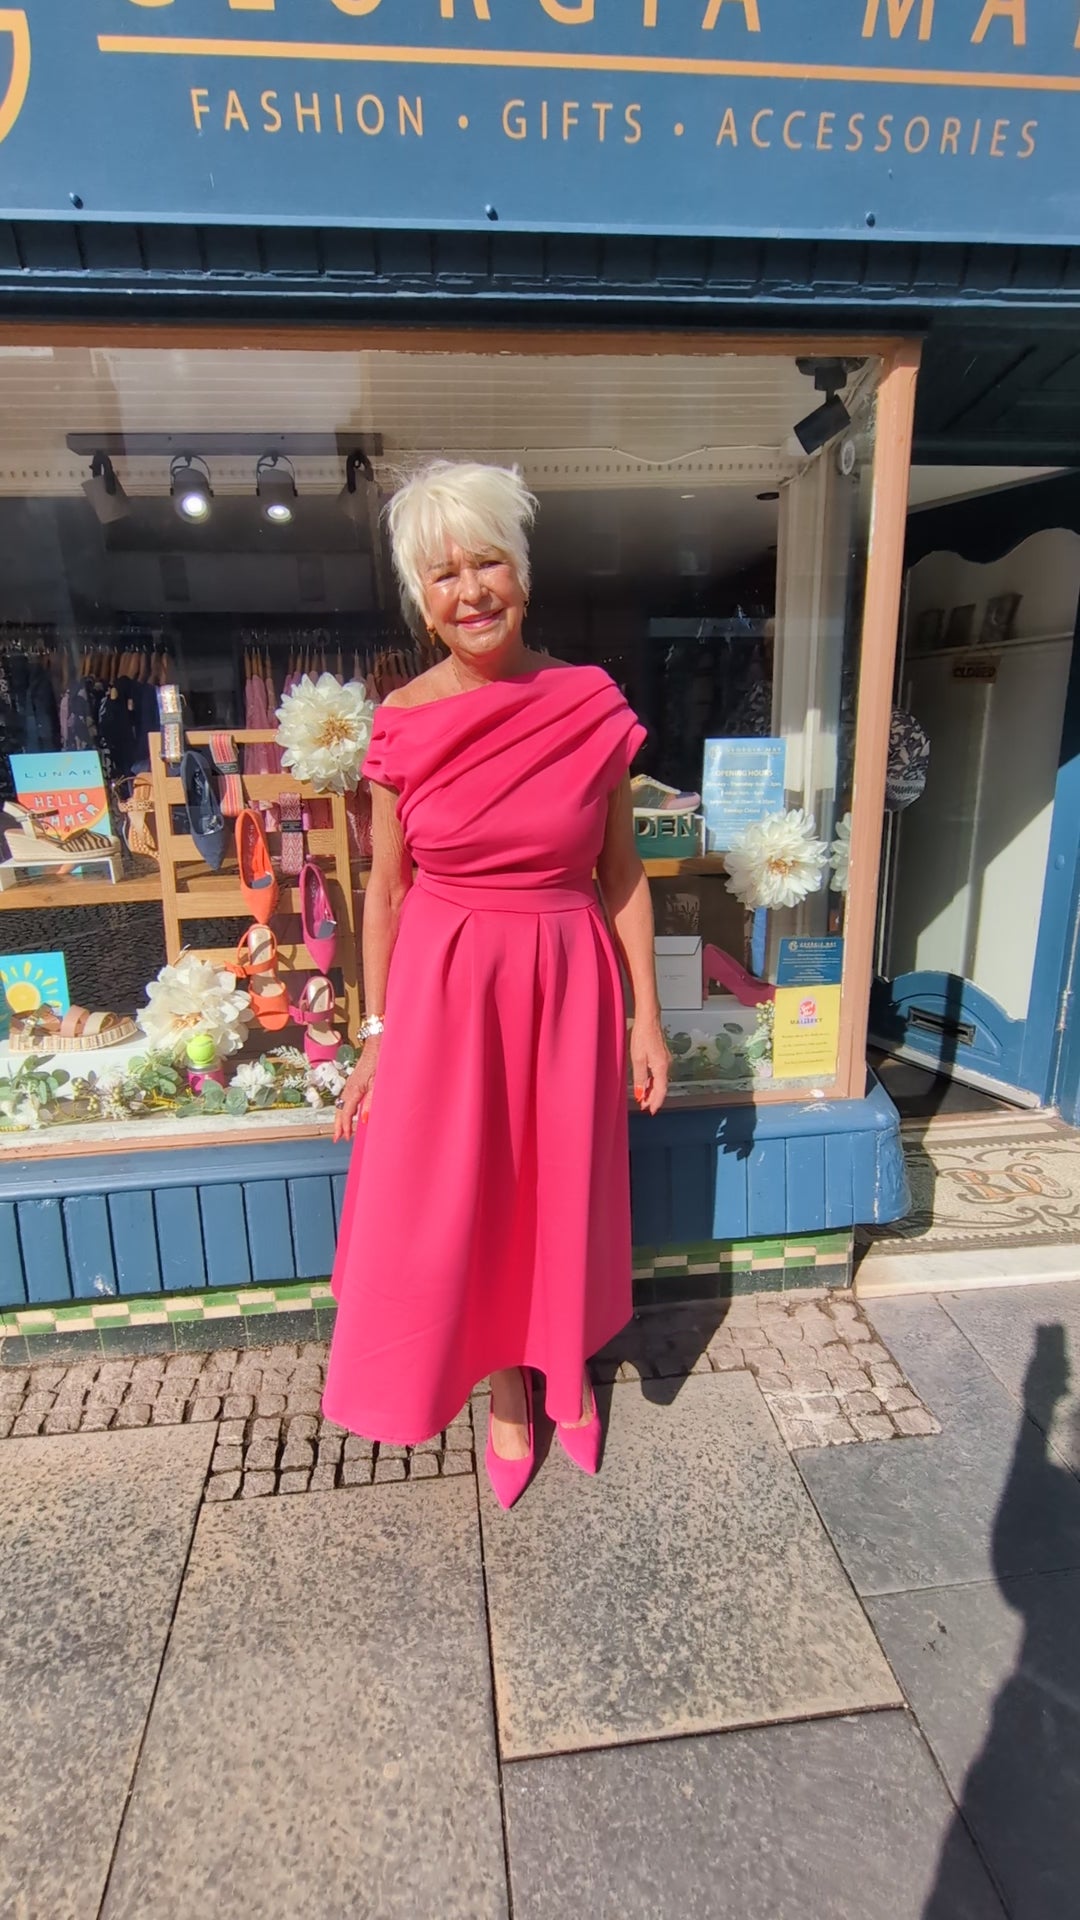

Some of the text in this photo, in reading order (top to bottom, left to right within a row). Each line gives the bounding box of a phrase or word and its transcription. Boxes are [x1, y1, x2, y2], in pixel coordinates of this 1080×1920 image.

[190, 88, 1038, 158] FASHION GIFTS ACCESSORIES
[24, 769, 92, 779] LUNAR
[34, 792, 89, 808] HELLO
